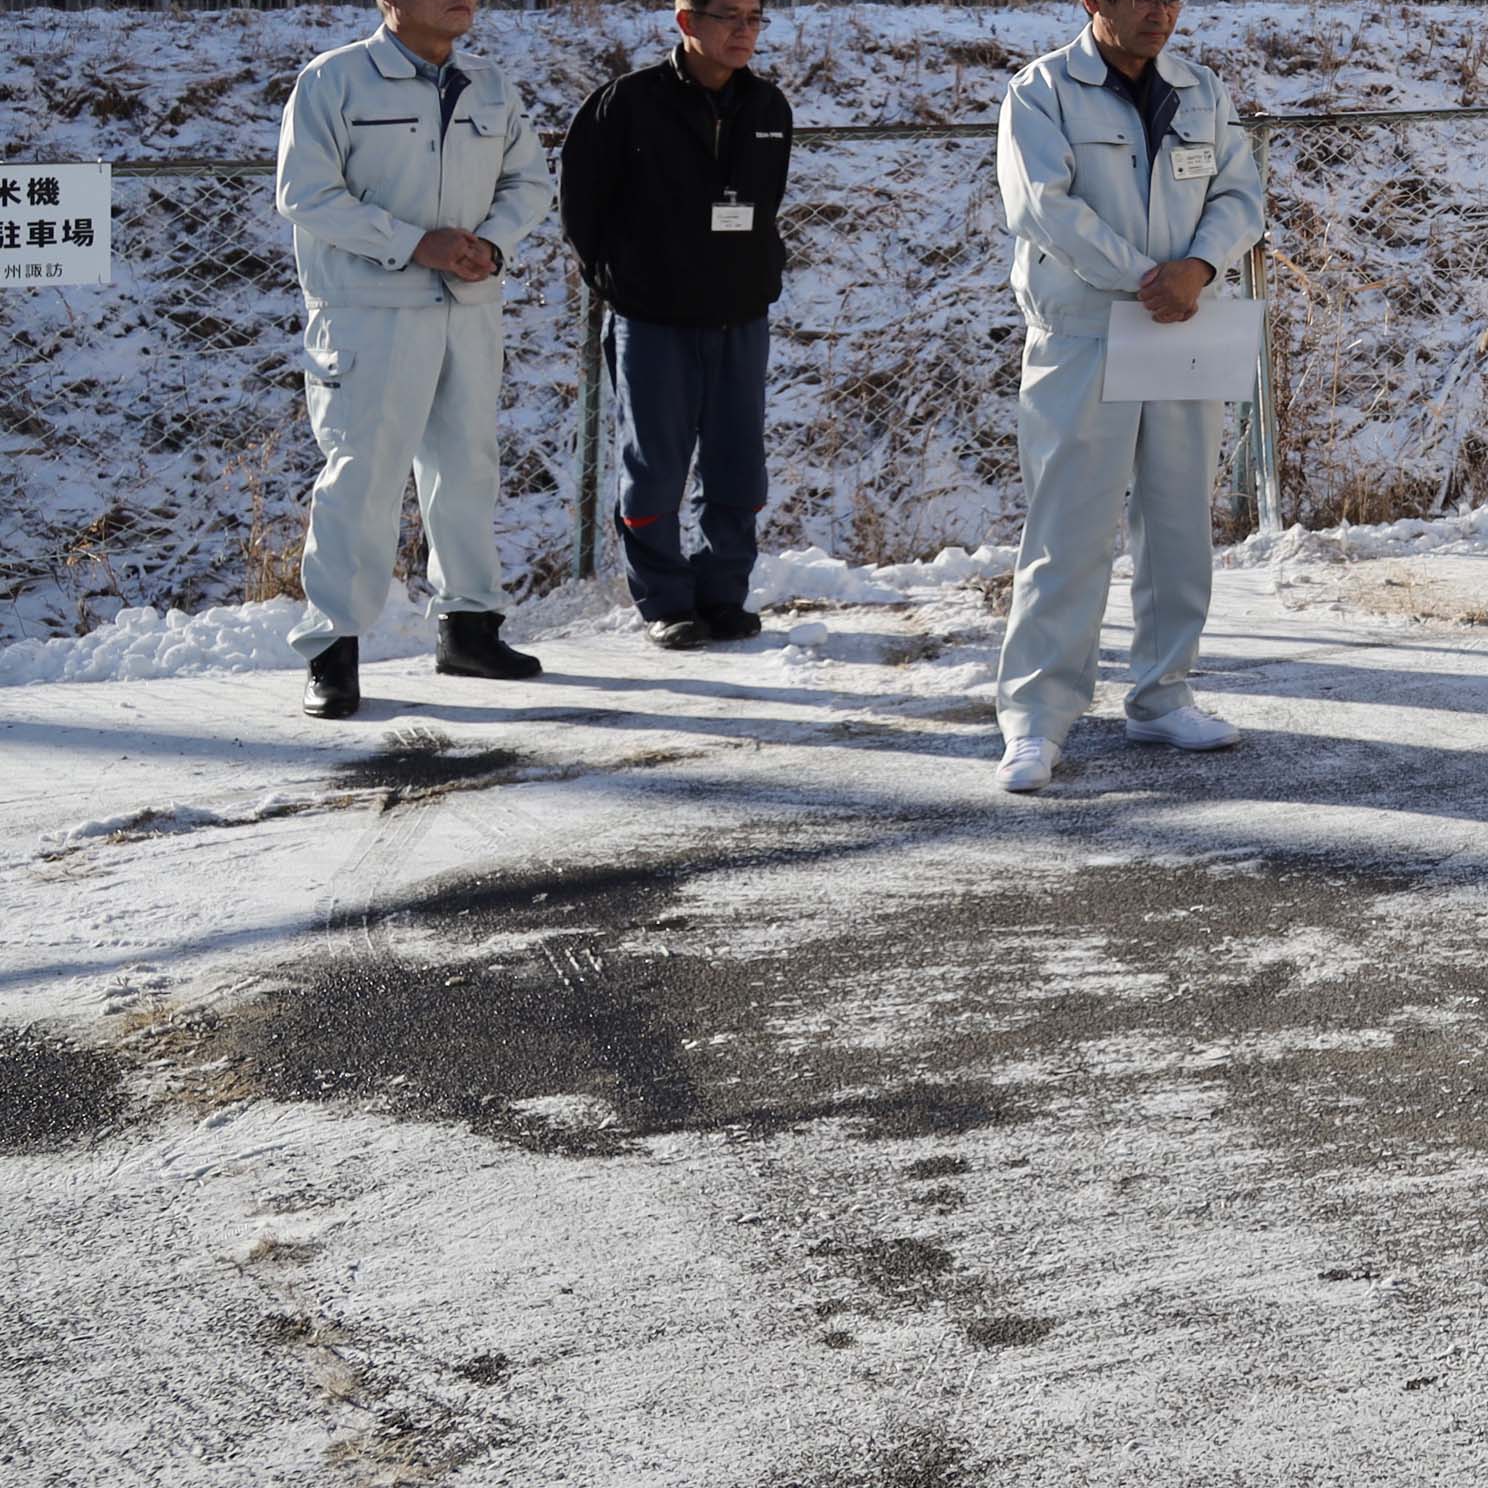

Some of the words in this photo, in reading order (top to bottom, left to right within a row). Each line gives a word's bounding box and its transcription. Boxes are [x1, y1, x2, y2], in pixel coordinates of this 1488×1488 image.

[0, 177, 60, 207] 米機
[0, 218, 94, 248] 駐車場
[4, 262, 62, 279] 州諏訪
